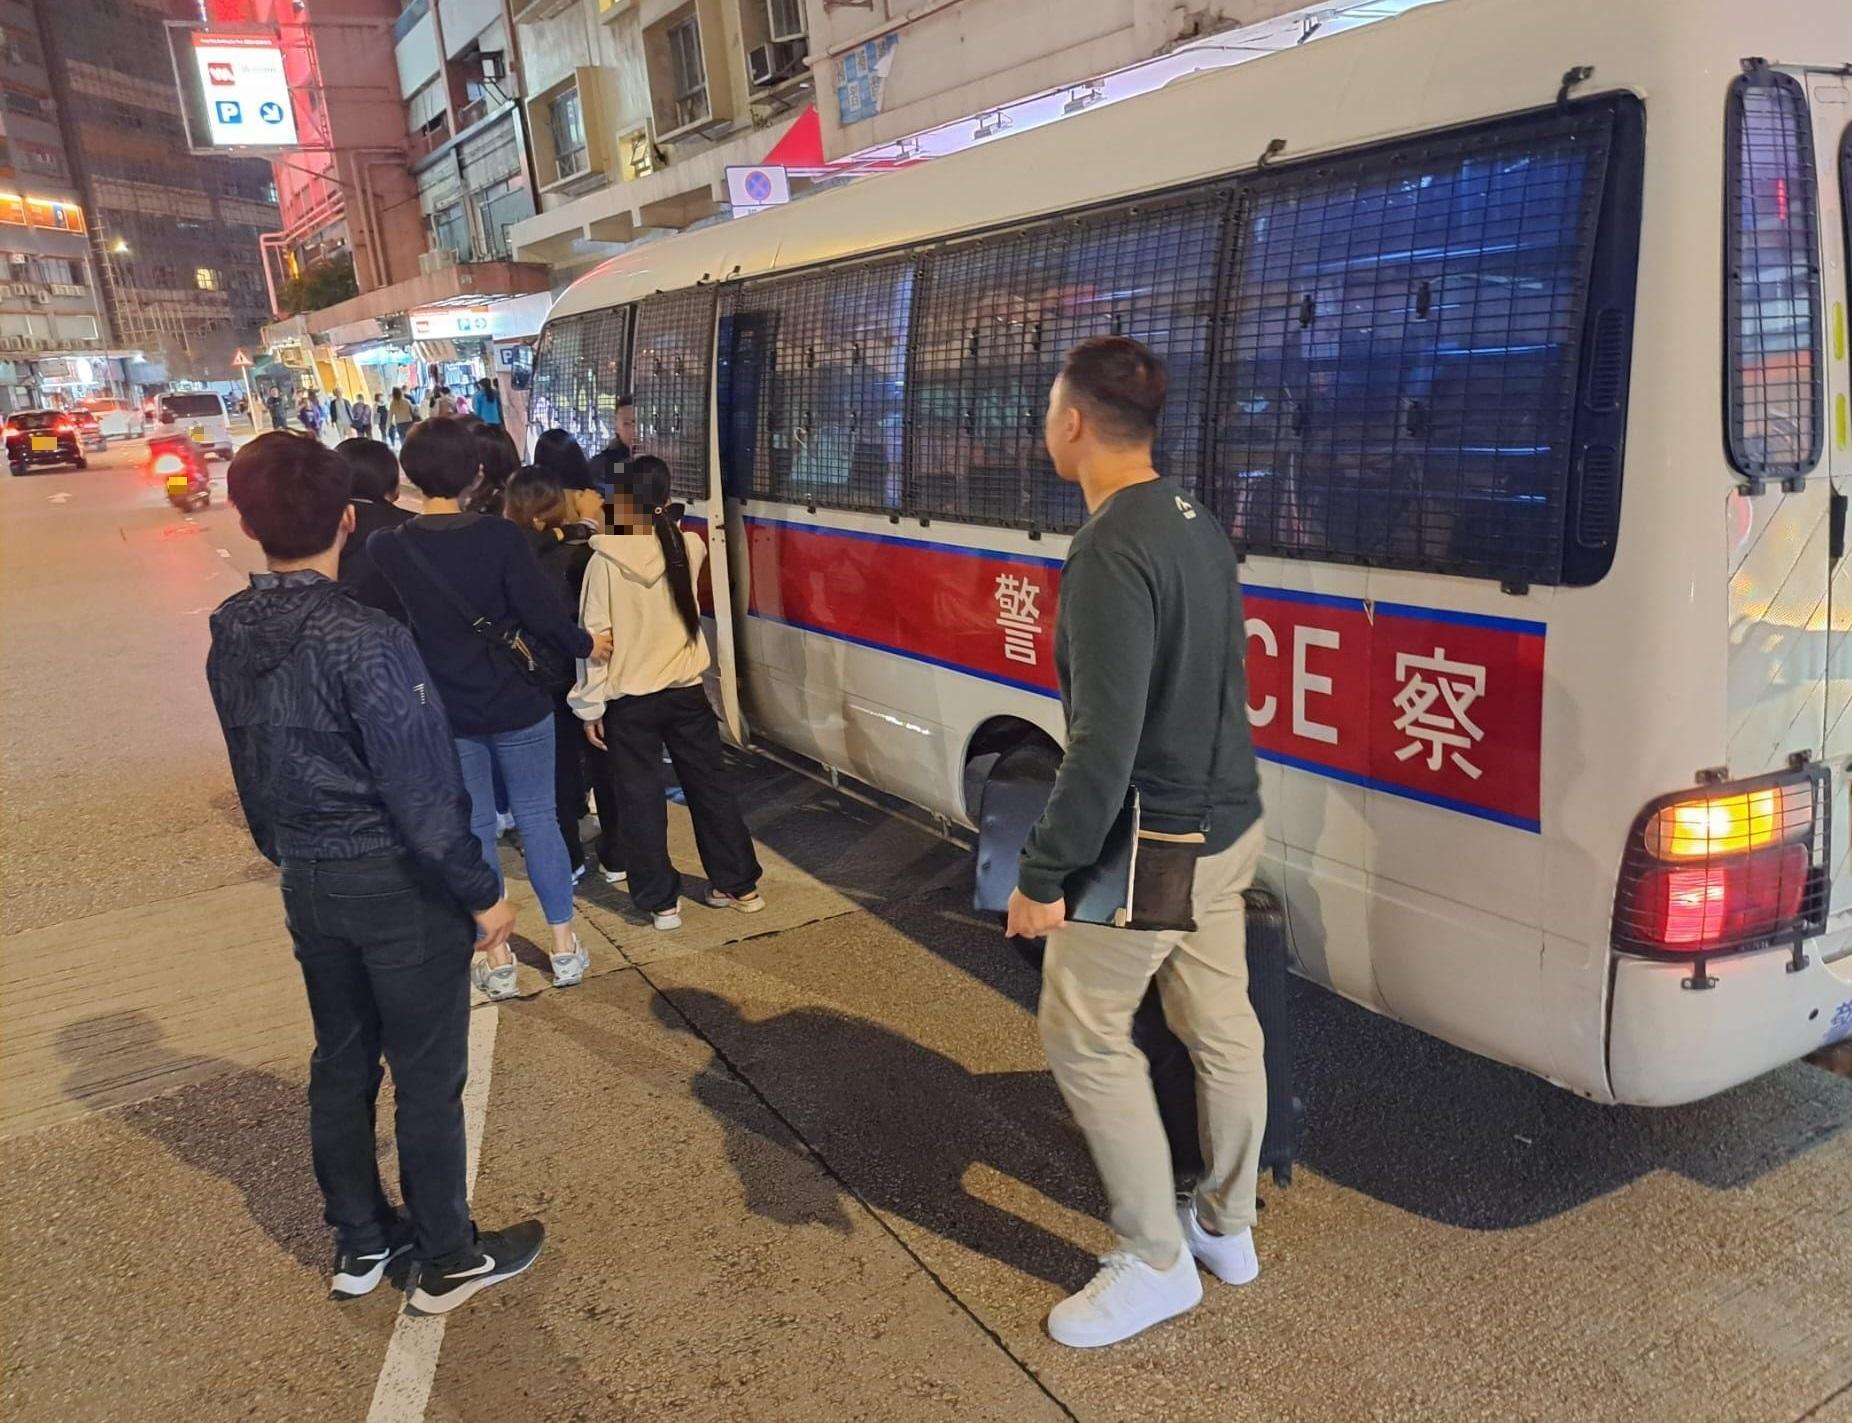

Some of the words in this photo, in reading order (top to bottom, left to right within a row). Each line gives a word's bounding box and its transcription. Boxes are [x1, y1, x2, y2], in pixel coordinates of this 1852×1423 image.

[220, 102, 239, 122] P
[502, 349, 513, 364] P
[994, 573, 1042, 665] 警
[1393, 647, 1486, 780] 察
